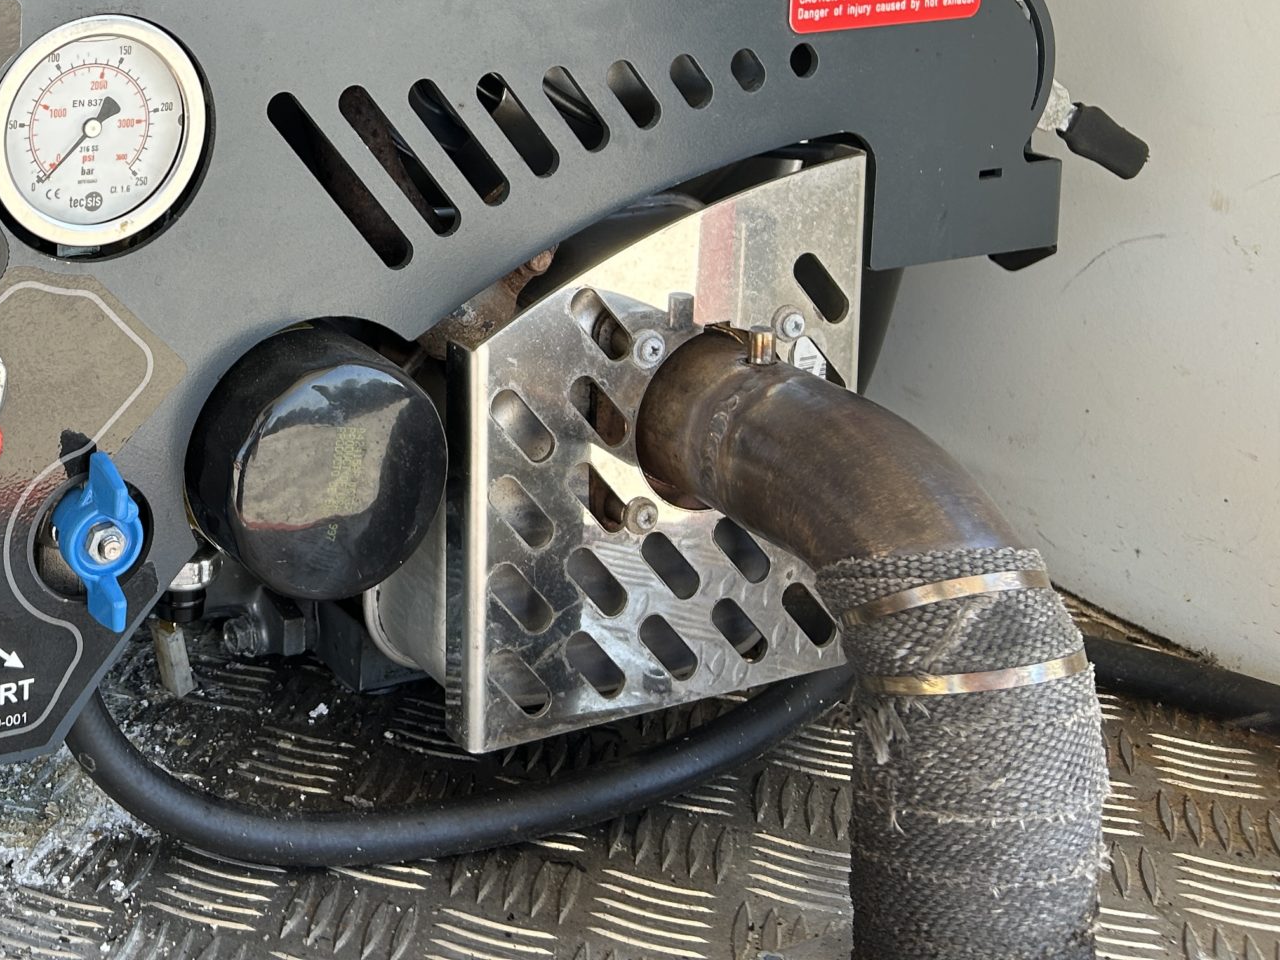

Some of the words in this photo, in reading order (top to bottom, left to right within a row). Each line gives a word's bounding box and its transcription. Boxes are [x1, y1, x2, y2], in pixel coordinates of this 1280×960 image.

[798, 7, 828, 21] Danger
[834, 5, 842, 15] of
[847, 2, 871, 16] injury
[876, 0, 905, 12] caused
[911, 0, 920, 11] by
[119, 46, 132, 55] 150
[47, 53, 60, 62] 100
[91, 81, 107, 90] 2000
[72, 100, 85, 108] EN
[161, 102, 173, 112] 200
[50, 108, 66, 118] 1000
[9, 120, 17, 130] 50
[117, 119, 134, 128] 3000
[82, 154, 95, 163] psi
[81, 166, 94, 175] bar
[135, 176, 148, 186] 250
[70, 192, 102, 208] tecsis
